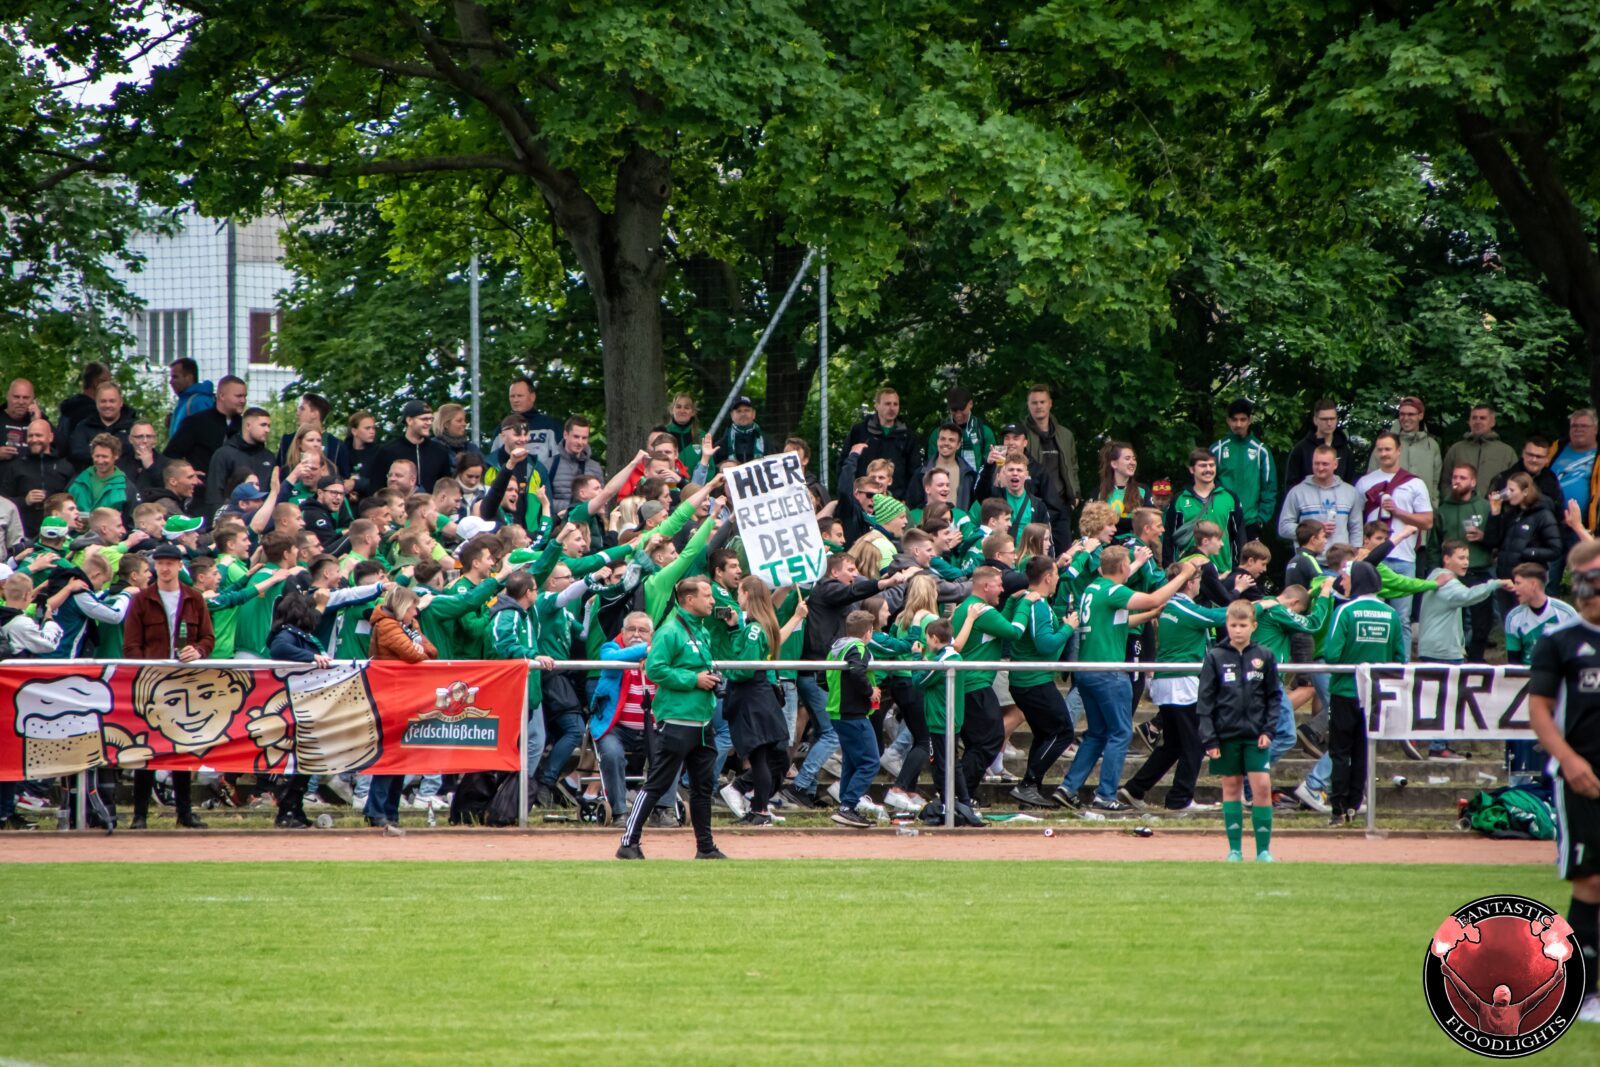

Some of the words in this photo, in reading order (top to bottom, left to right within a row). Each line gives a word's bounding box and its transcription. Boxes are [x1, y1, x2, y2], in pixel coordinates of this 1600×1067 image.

[732, 455, 805, 500] HIER
[758, 524, 813, 560] DER
[759, 547, 822, 587] TSV
